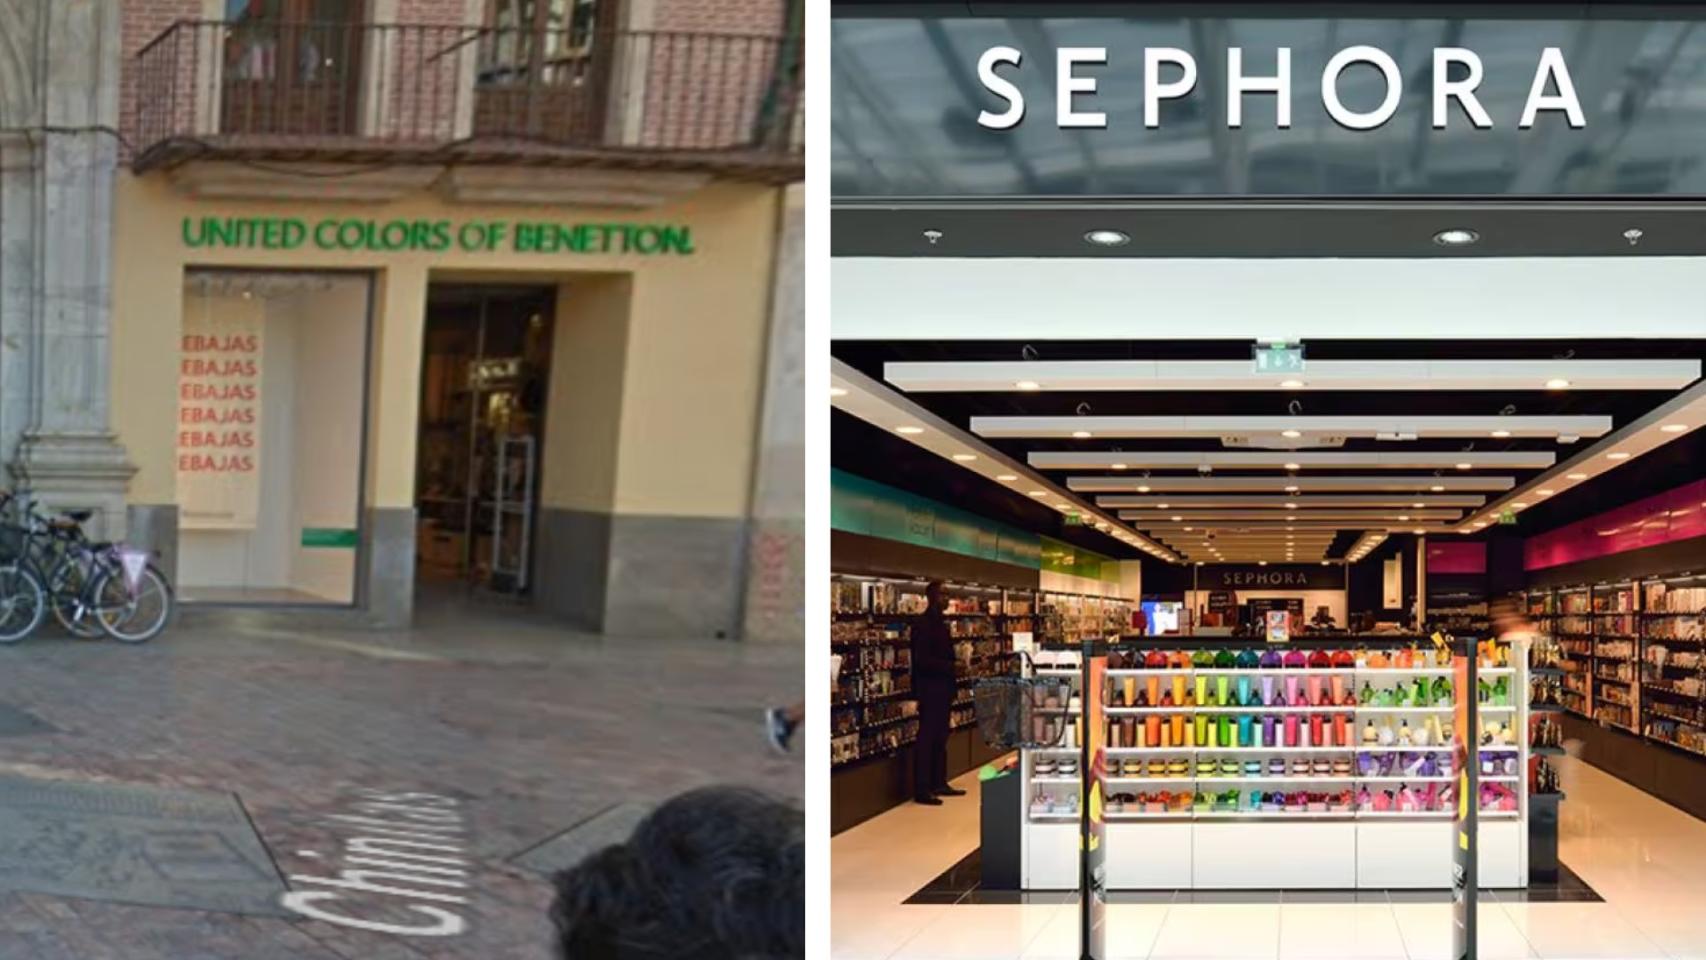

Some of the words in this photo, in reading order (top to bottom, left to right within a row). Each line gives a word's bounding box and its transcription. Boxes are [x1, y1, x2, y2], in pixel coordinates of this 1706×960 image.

[977, 45, 1587, 130] SEPHORA
[182, 218, 305, 249] UNITED
[313, 219, 450, 252] COLORS
[458, 221, 507, 251] OF
[1223, 571, 1308, 585] SEPHORA
